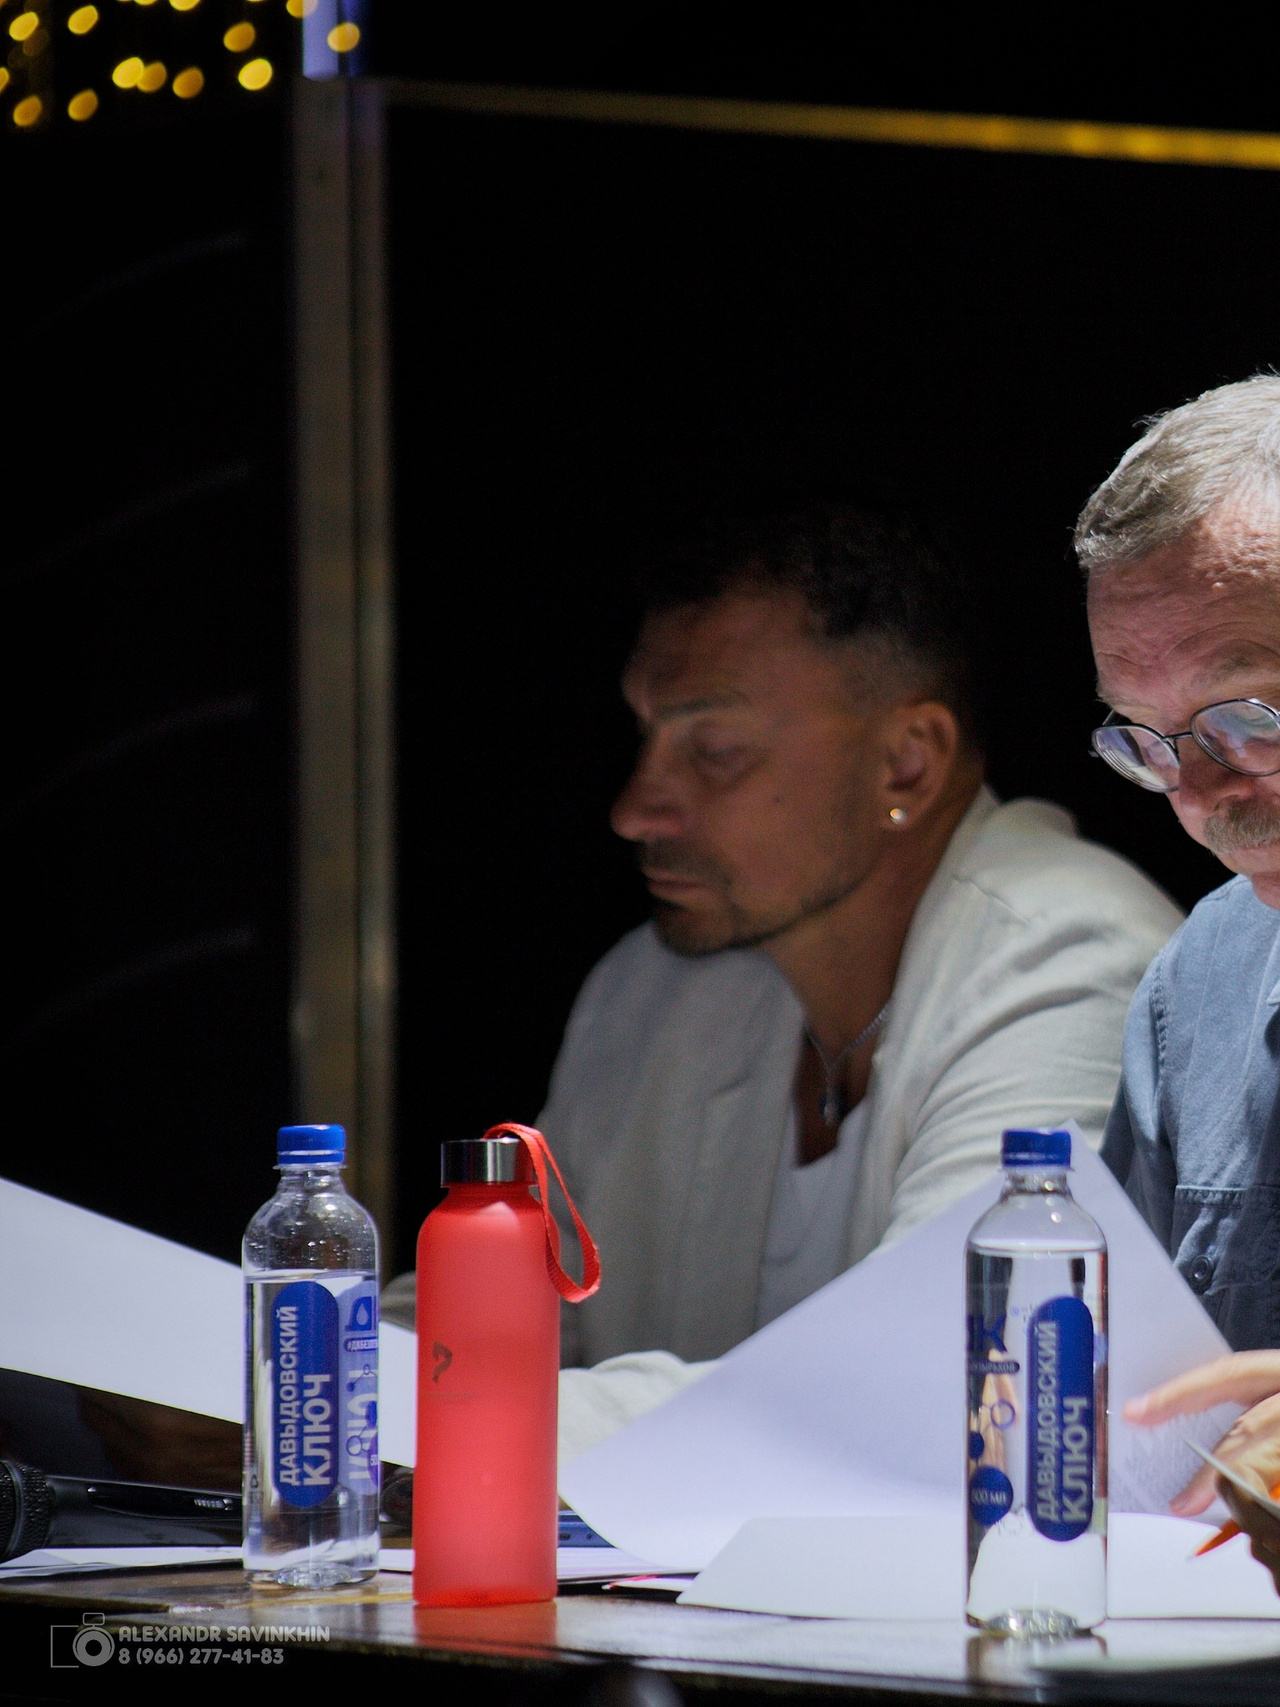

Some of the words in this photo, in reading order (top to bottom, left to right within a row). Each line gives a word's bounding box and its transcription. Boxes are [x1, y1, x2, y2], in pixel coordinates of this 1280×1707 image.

[276, 1305, 299, 1487] ДАВЫДОВСКИЙ
[302, 1374, 331, 1487] КЛЮЧ
[1035, 1322, 1058, 1523] ДАВЫДОВСКИЙ
[1062, 1397, 1088, 1526] КЛЮЧ
